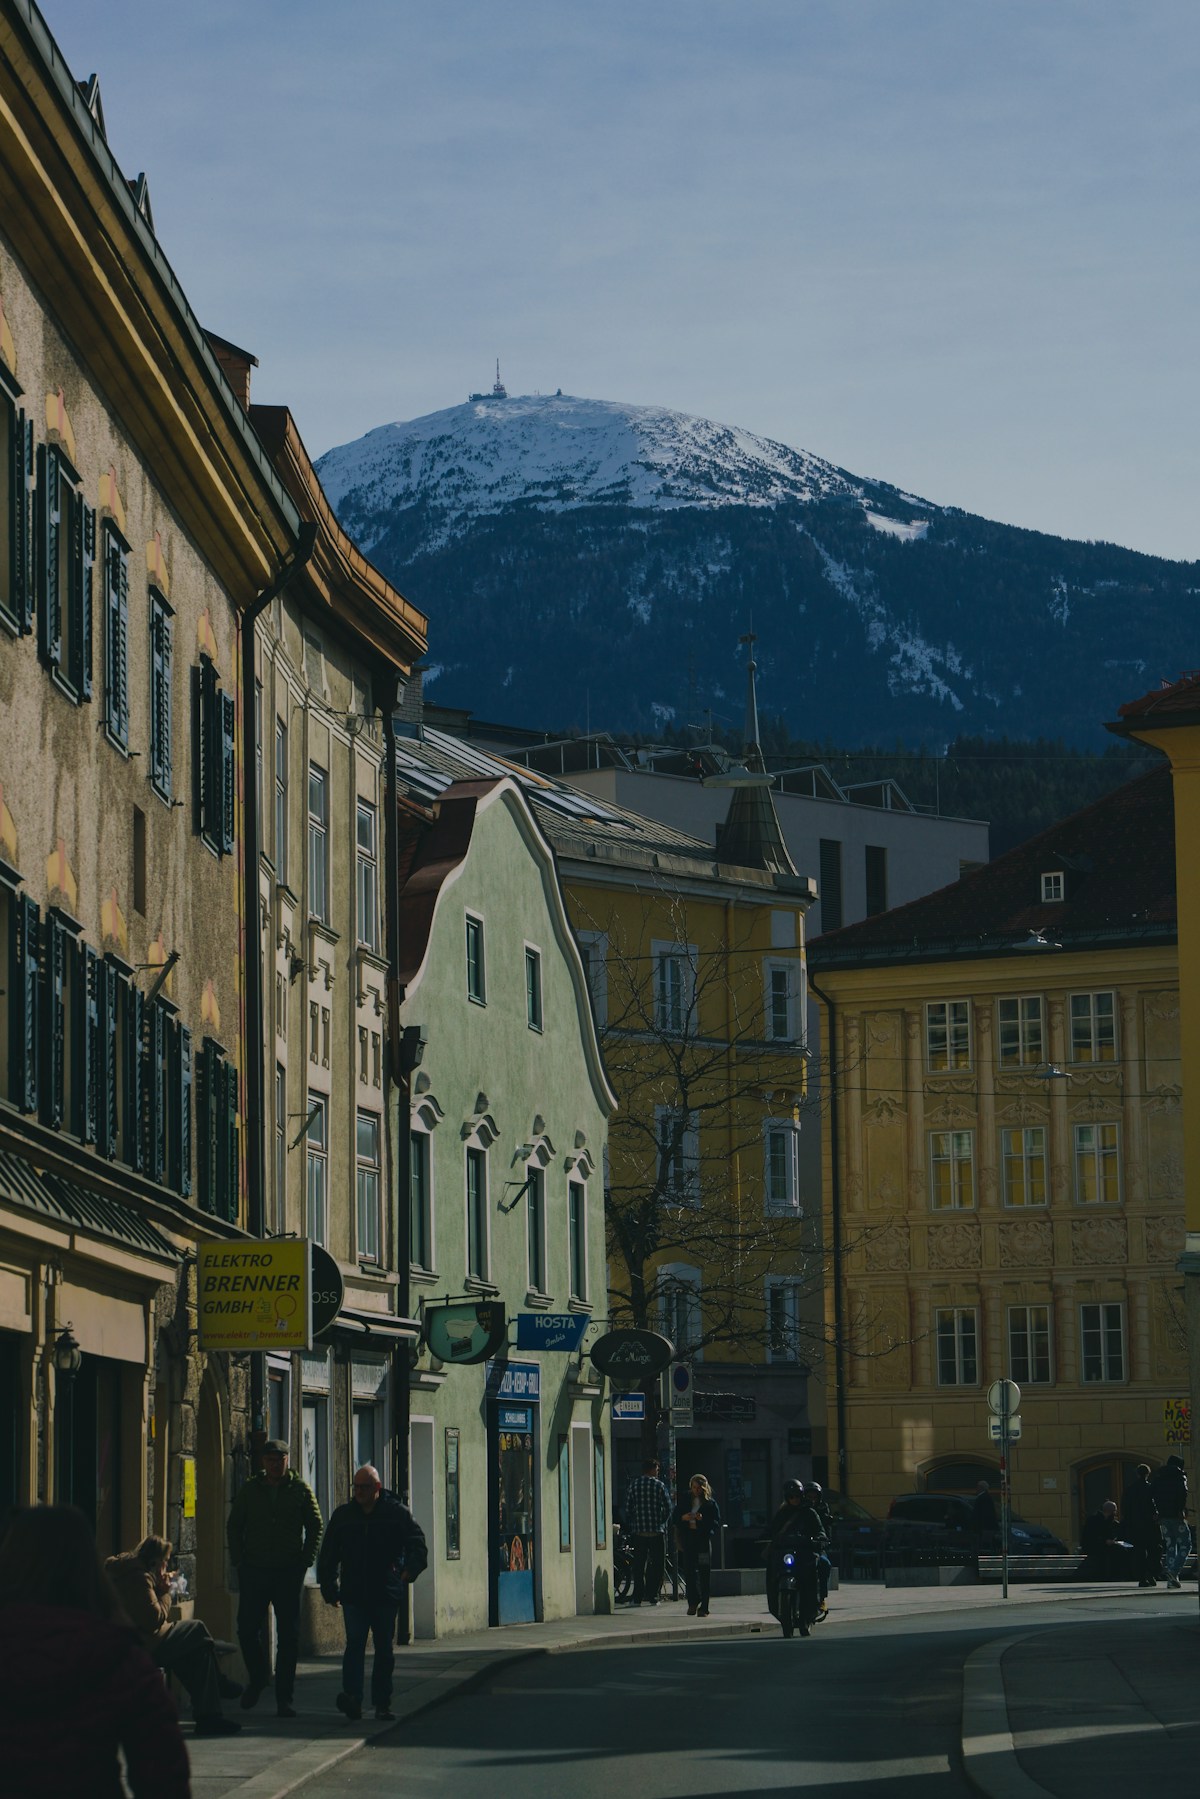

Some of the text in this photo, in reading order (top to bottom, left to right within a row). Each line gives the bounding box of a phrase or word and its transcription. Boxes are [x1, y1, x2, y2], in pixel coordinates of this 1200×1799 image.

[204, 1254, 273, 1268] ELEKTRO
[204, 1275, 300, 1292] BRENNER
[204, 1300, 254, 1314] GMBH
[535, 1316, 577, 1329] HOSTA
[203, 1330, 302, 1340] www.elektr-brenner.at
[619, 1401, 640, 1411] EINBAHN
[673, 1394, 691, 1407] Zone
